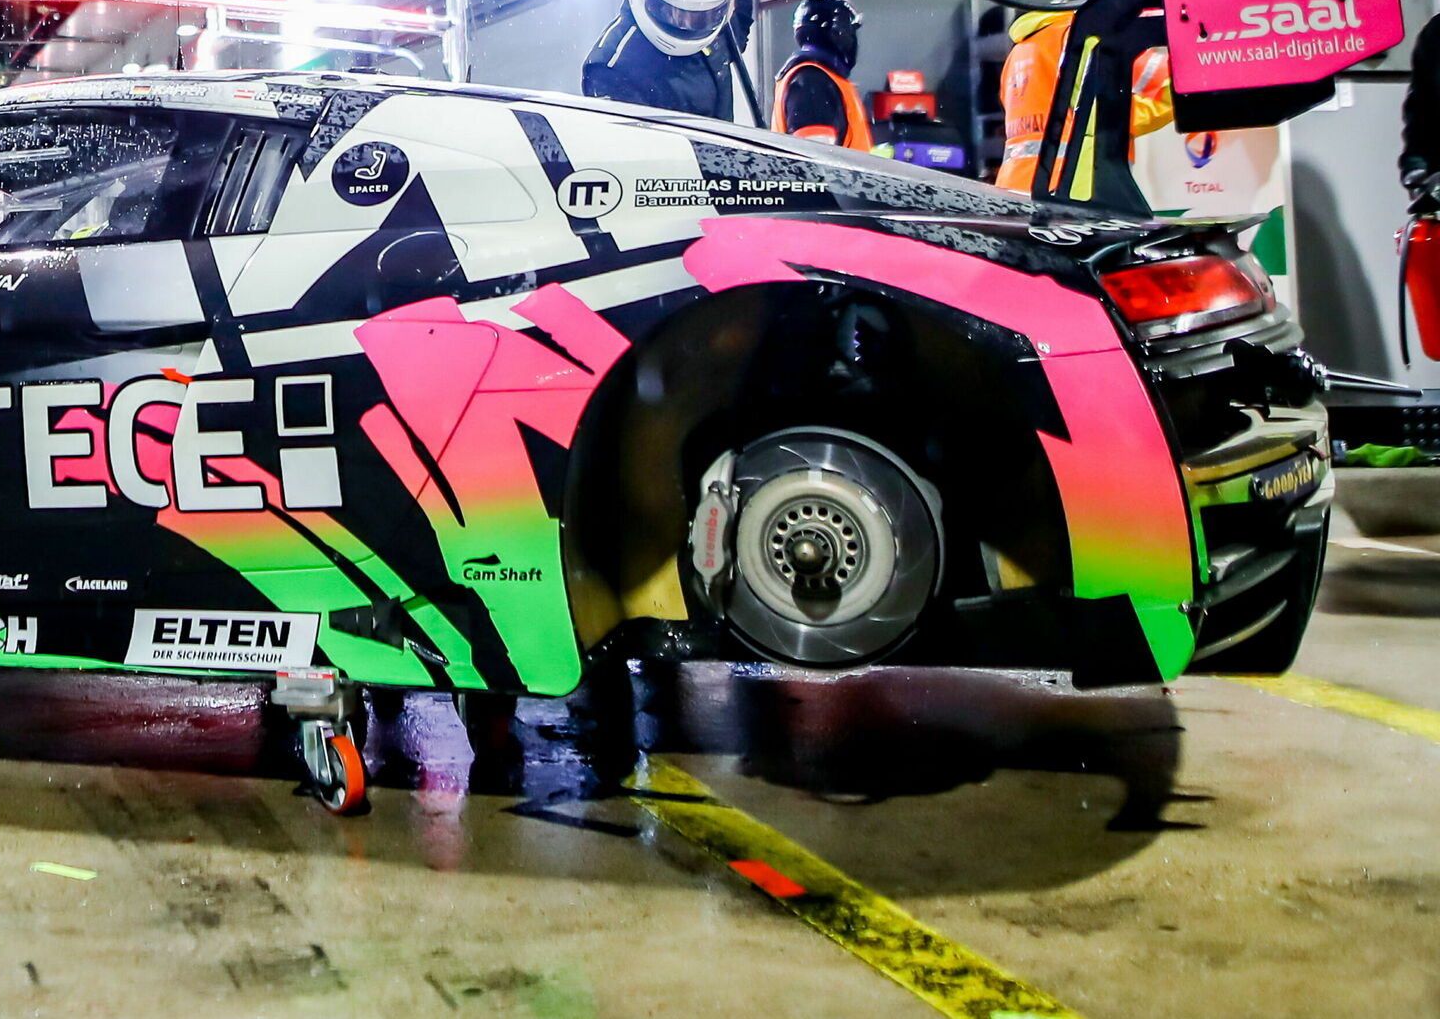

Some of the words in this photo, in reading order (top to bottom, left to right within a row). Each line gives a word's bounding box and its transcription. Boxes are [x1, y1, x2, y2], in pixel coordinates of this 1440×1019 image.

[1197, 34, 1365, 66] www.saal-digital.de
[348, 184, 389, 194] SPACER
[636, 179, 732, 192] MATTHIAS
[738, 179, 829, 193] RUPPERT
[1185, 181, 1224, 193] TOTAL
[635, 194, 785, 207] Bauunternehmen
[463, 567, 496, 581] Cam
[499, 566, 543, 582] Shaft
[75, 580, 128, 591] RACELAND
[152, 617, 292, 648] ELTEN
[152, 649, 173, 660] DER
[176, 650, 283, 665] SICHERHEITSSCHUH
